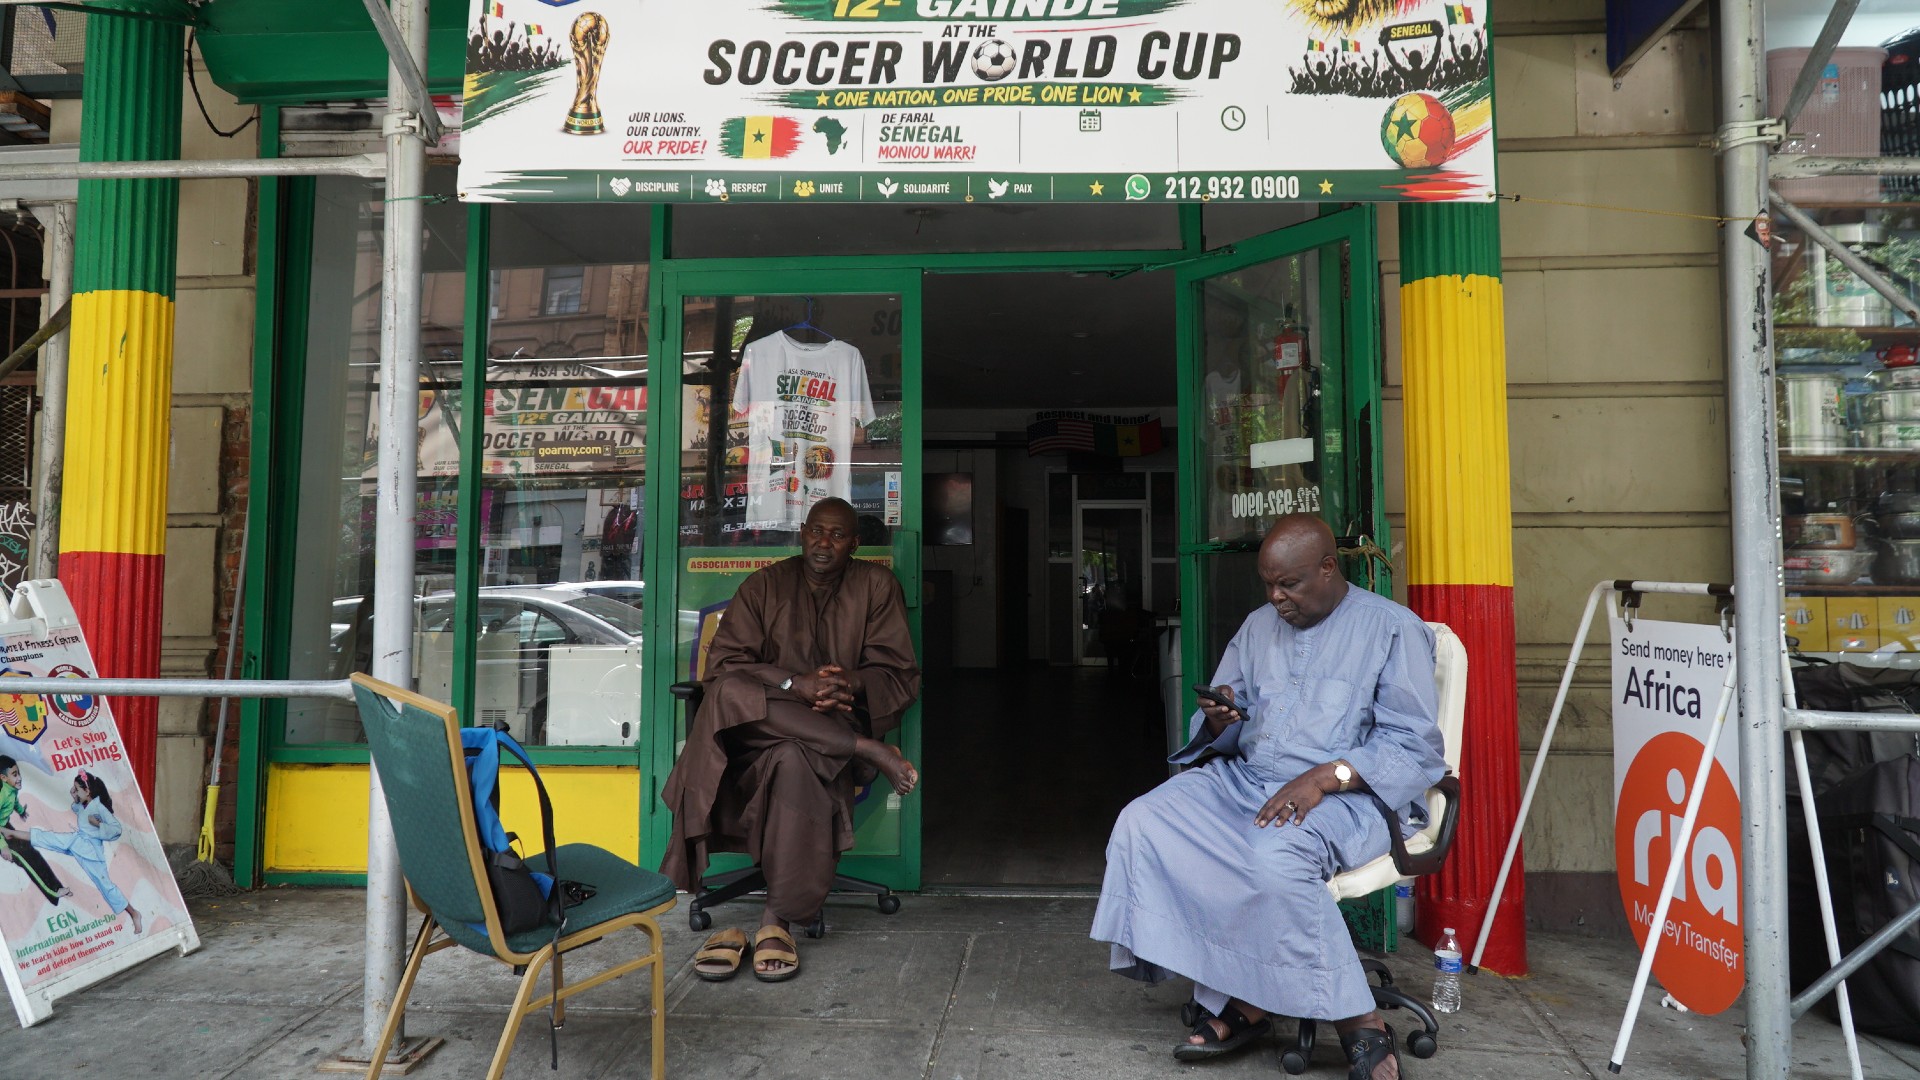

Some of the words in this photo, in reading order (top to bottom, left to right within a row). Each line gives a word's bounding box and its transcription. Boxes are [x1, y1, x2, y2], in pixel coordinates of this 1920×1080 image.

[942, 25, 959, 37] AT
[968, 25, 997, 37] THE
[1391, 23, 1432, 38] SENEGAL
[703, 39, 902, 85] SOCCER
[1137, 31, 1241, 80] CUP
[834, 91, 868, 106] ONE
[873, 91, 937, 107] NATION,
[943, 87, 978, 103] ONE
[983, 86, 1035, 104] PRIDE,
[1041, 85, 1077, 103] ONE
[1082, 87, 1123, 104] LION
[629, 112, 650, 122] OUR
[654, 112, 686, 122] LIONS.
[882, 113, 896, 123] DE
[900, 112, 935, 123] FARAL
[627, 126, 648, 137] OUR
[652, 126, 701, 137] COUNTRY.
[879, 123, 963, 143] SÉNÉGAL
[623, 140, 652, 155] OUR
[657, 140, 707, 155] PRIDE!
[878, 145, 932, 160] MONIOU
[934, 145, 976, 160] WARR!
[635, 182, 679, 192] DISCIPLINE
[731, 182, 767, 193] RESPECT
[819, 182, 843, 194] UNITÉ
[903, 182, 950, 194] SOLIDARITÉ
[1013, 183, 1033, 193] PAIX
[1165, 176, 1201, 199] 212
[1208, 176, 1244, 198] 932
[1251, 175, 1299, 198] 0900
[530, 365, 557, 377] ASA
[777, 375, 836, 401] SENEGAL
[552, 411, 638, 424] GAINDE
[1036, 411, 1085, 421] Respect
[1088, 413, 1111, 423] and
[1114, 414, 1150, 424] Honor
[483, 431, 546, 449] OCCER
[538, 445, 601, 457] goarmy.com
[691, 561, 752, 569] ASSOCIATION
[0, 652, 44, 664] Champions
[1621, 638, 1650, 658] Send
[1654, 646, 1693, 668] money
[1697, 646, 1724, 668] here
[1623, 666, 1701, 719] Africa
[14, 724, 41, 735] A.S.A.
[53, 736, 81, 751] Let's
[83, 731, 107, 744] Stop
[51, 741, 122, 772] Bullying
[1633, 768, 1738, 926] ria
[46, 909, 79, 933] EGN
[15, 929, 74, 958] International
[75, 914, 116, 935] Karate-Do
[1634, 900, 1681, 945] Moey
[1682, 921, 1739, 970] Transfer
[18, 961, 30, 970] We
[31, 952, 52, 965] teach
[53, 945, 69, 957] kids
[69, 940, 84, 951] how
[85, 935, 93, 944] to
[94, 928, 113, 940] stand
[114, 924, 123, 932] up
[37, 965, 51, 976] and
[52, 953, 77, 970] defend
[77, 939, 115, 959] themselves
